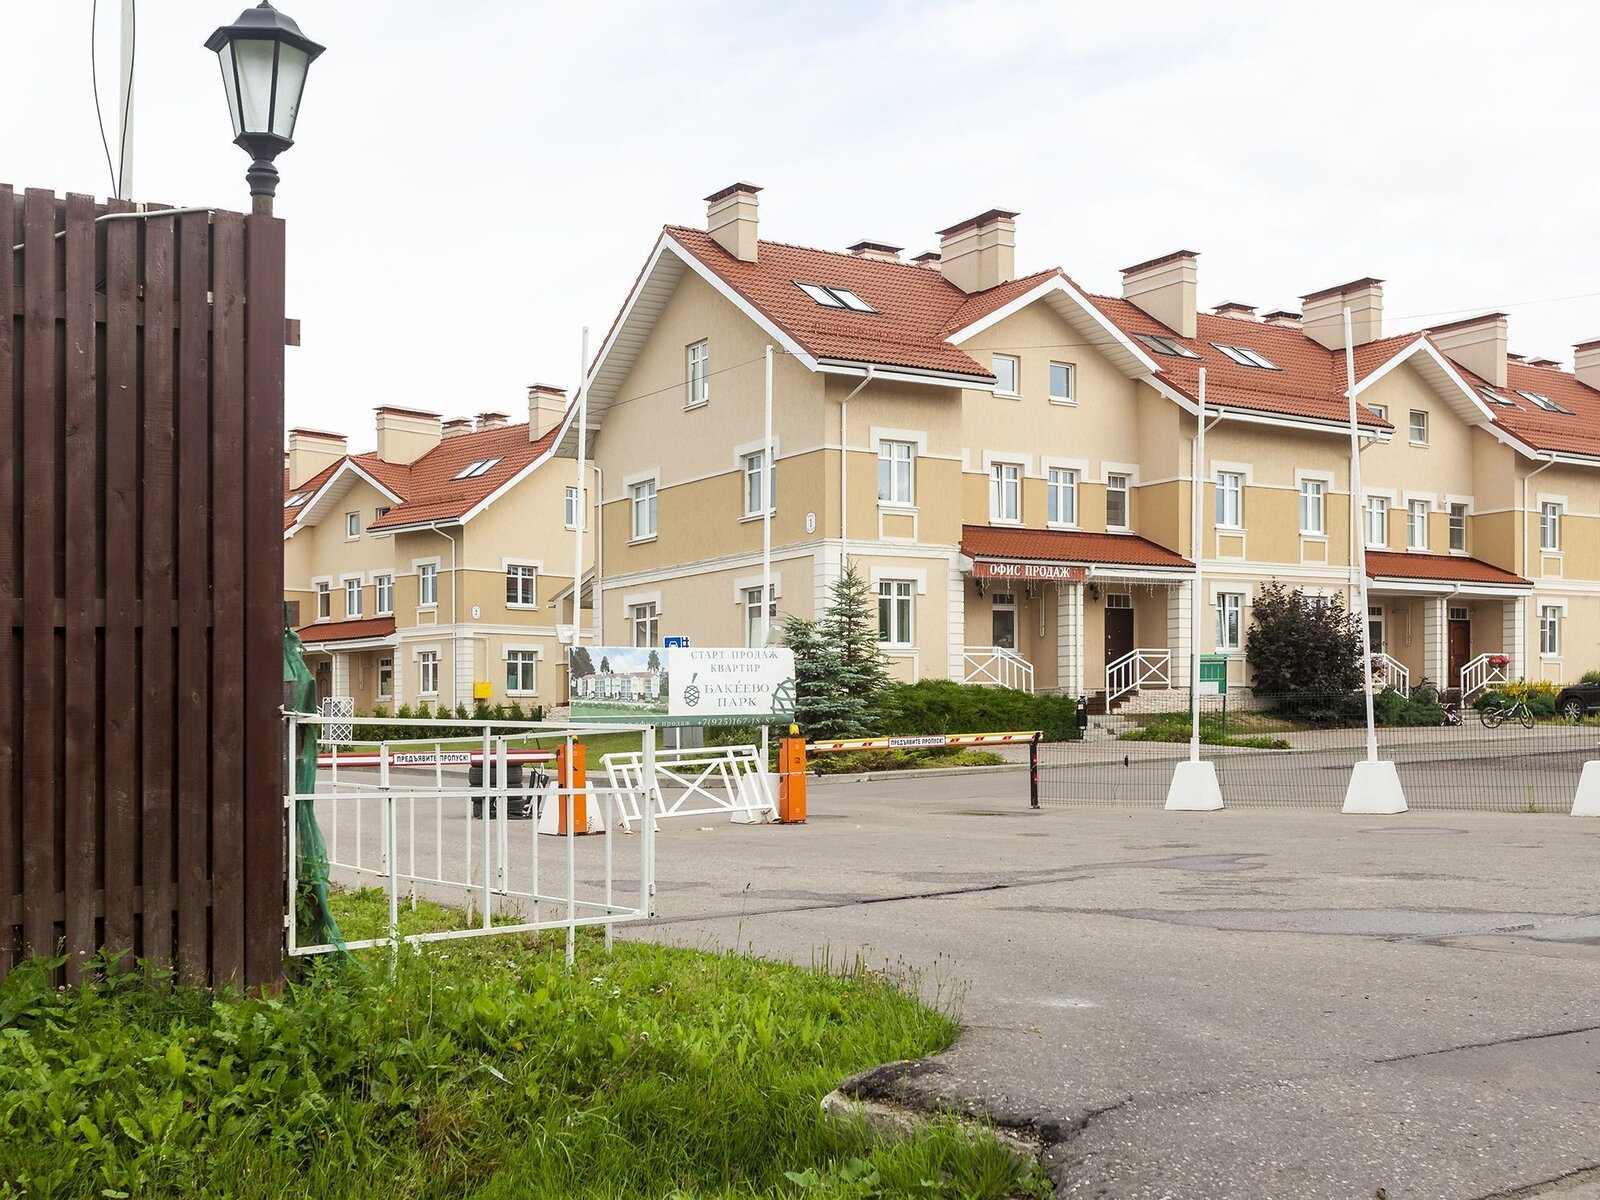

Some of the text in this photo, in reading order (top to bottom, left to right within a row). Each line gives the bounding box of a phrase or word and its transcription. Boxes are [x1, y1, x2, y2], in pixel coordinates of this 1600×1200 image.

[989, 563, 1071, 579] ОФИС ПРОДАЖ
[691, 651, 778, 659] СТАРТ ПРОДАЖ
[710, 664, 760, 673] КВАРТИР
[718, 697, 758, 707] ПАРК
[440, 754, 468, 762] ПРОПУСК!
